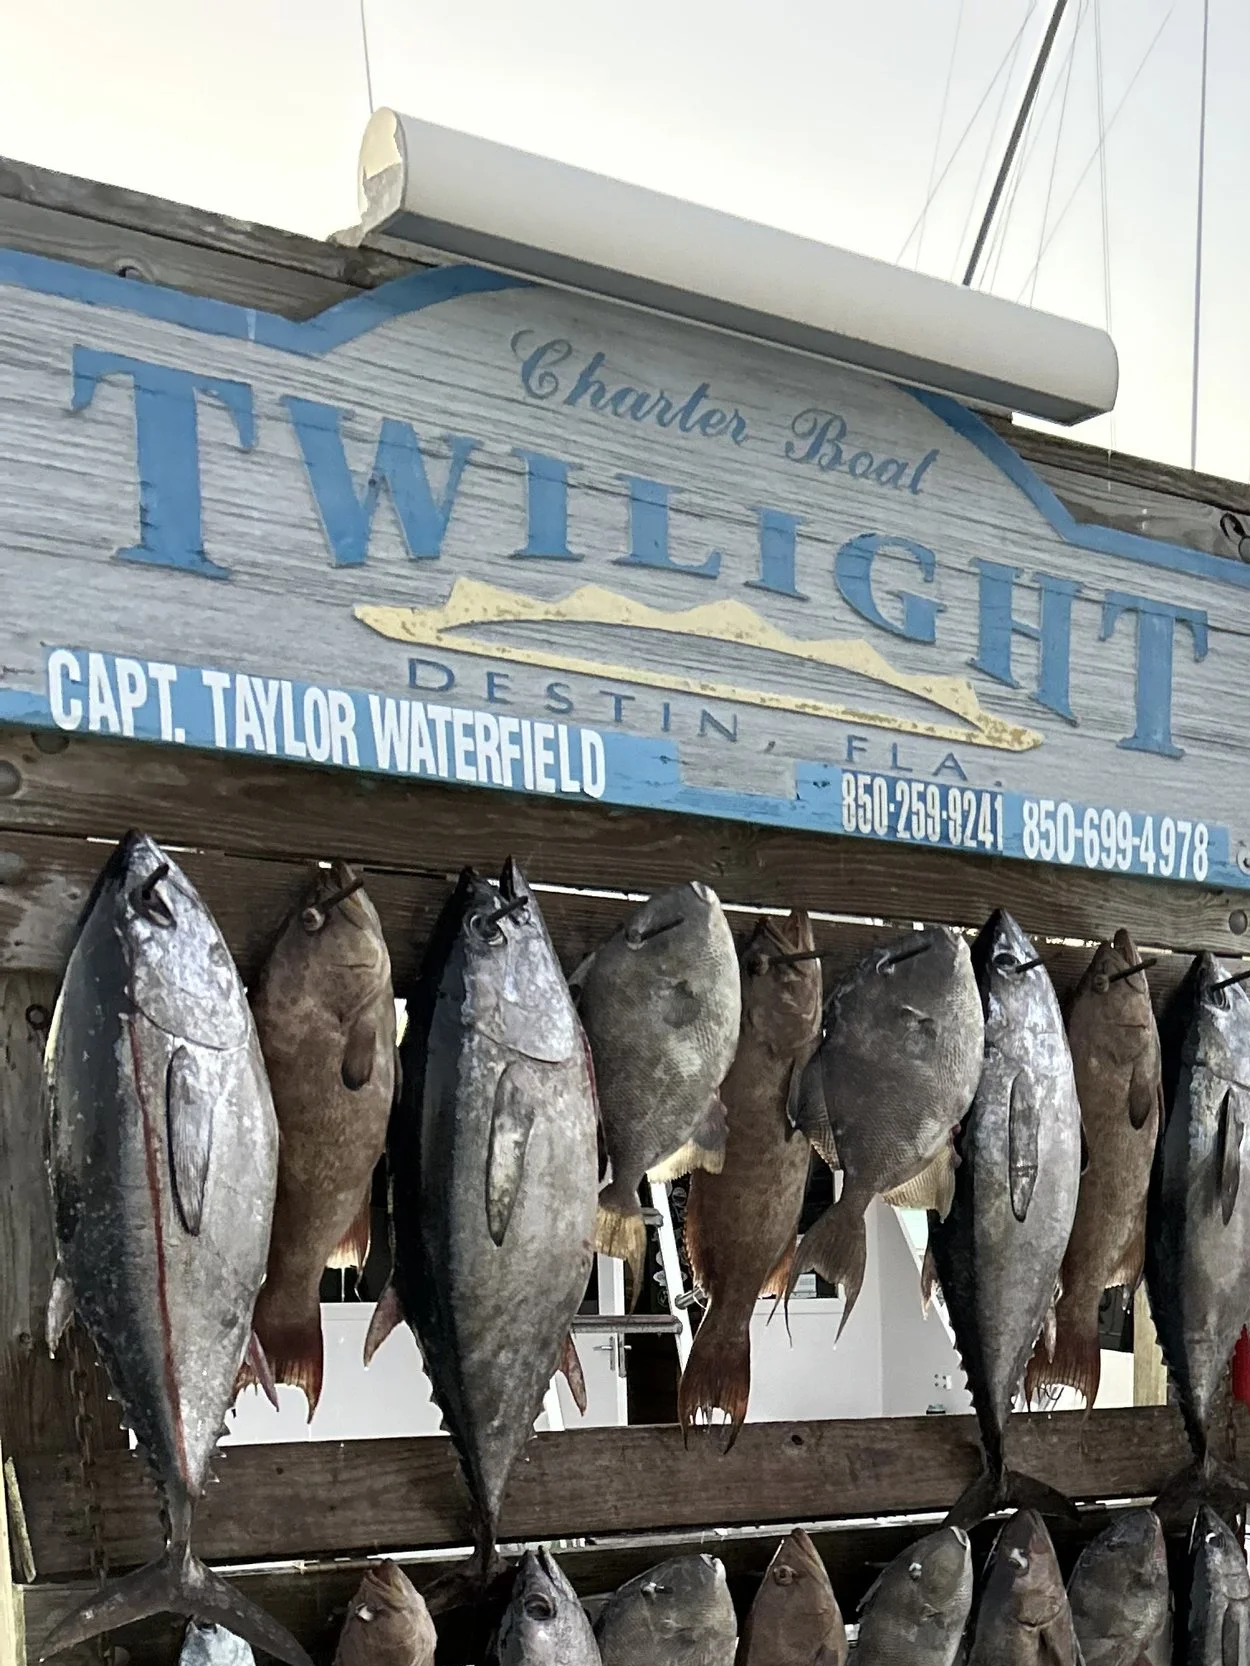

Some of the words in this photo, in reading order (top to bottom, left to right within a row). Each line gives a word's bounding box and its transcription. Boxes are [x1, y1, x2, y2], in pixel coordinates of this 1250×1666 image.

[510, 329, 749, 446] Charter
[784, 406, 941, 496] Boat
[66, 343, 1210, 760] TWILIGHT
[47, 648, 186, 744] CAPT.
[202, 669, 361, 767] TAYLOR
[368, 693, 607, 800] WATERFIELD
[407, 657, 777, 753] DESTIN,
[846, 733, 1002, 787] FLA.
[841, 772, 1004, 852] 850-259-9241
[1022, 799, 1210, 882] 850-699-4978
